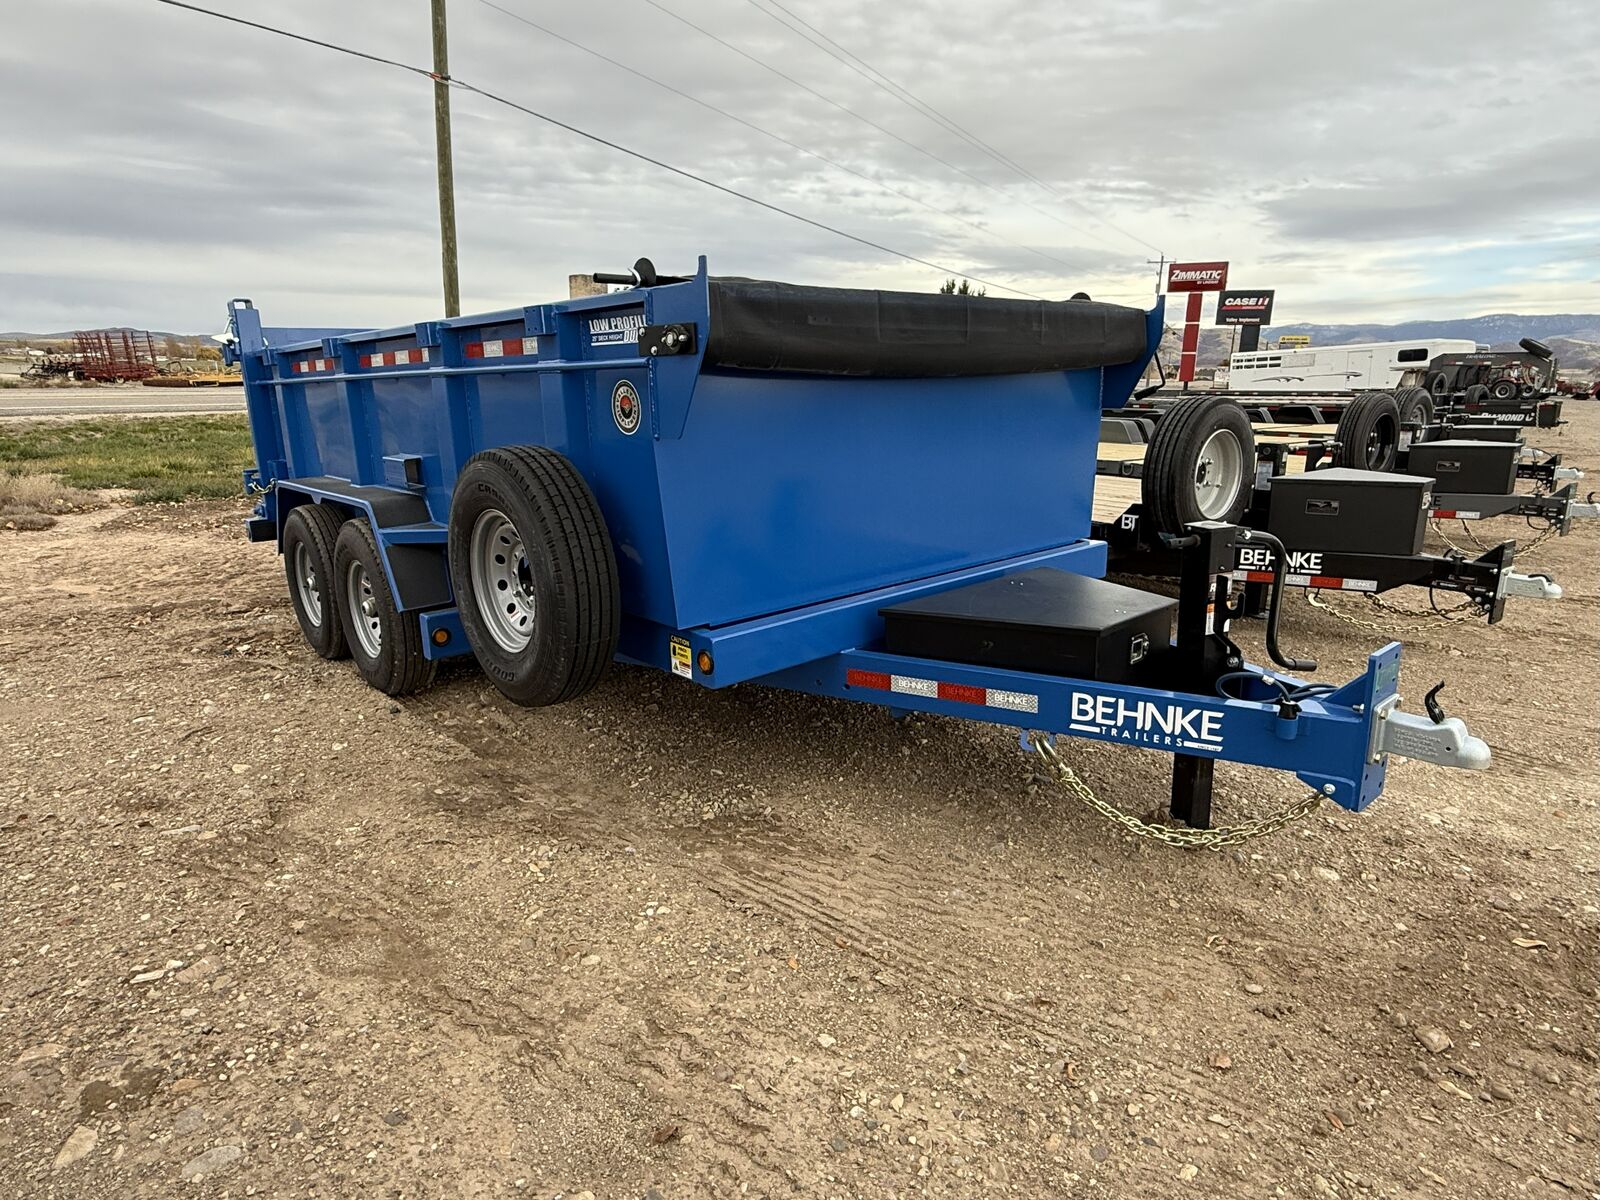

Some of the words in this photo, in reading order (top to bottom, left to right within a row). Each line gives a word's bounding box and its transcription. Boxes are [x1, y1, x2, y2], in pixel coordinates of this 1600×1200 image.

[1170, 270, 1222, 280] ZIMMATIC
[1224, 297, 1256, 306] CASE
[589, 318, 609, 332] LOW
[624, 329, 639, 343] DU
[1121, 514, 1139, 531] BT
[1239, 548, 1323, 570] BEHNKE
[1256, 565, 1300, 574] TRARS
[898, 680, 929, 691] BEHNKE
[945, 686, 977, 698] BEHNKE
[994, 693, 1028, 706] BEHNKE
[1071, 692, 1224, 742] BEHNKE
[1100, 726, 1183, 747] TRAILERS
